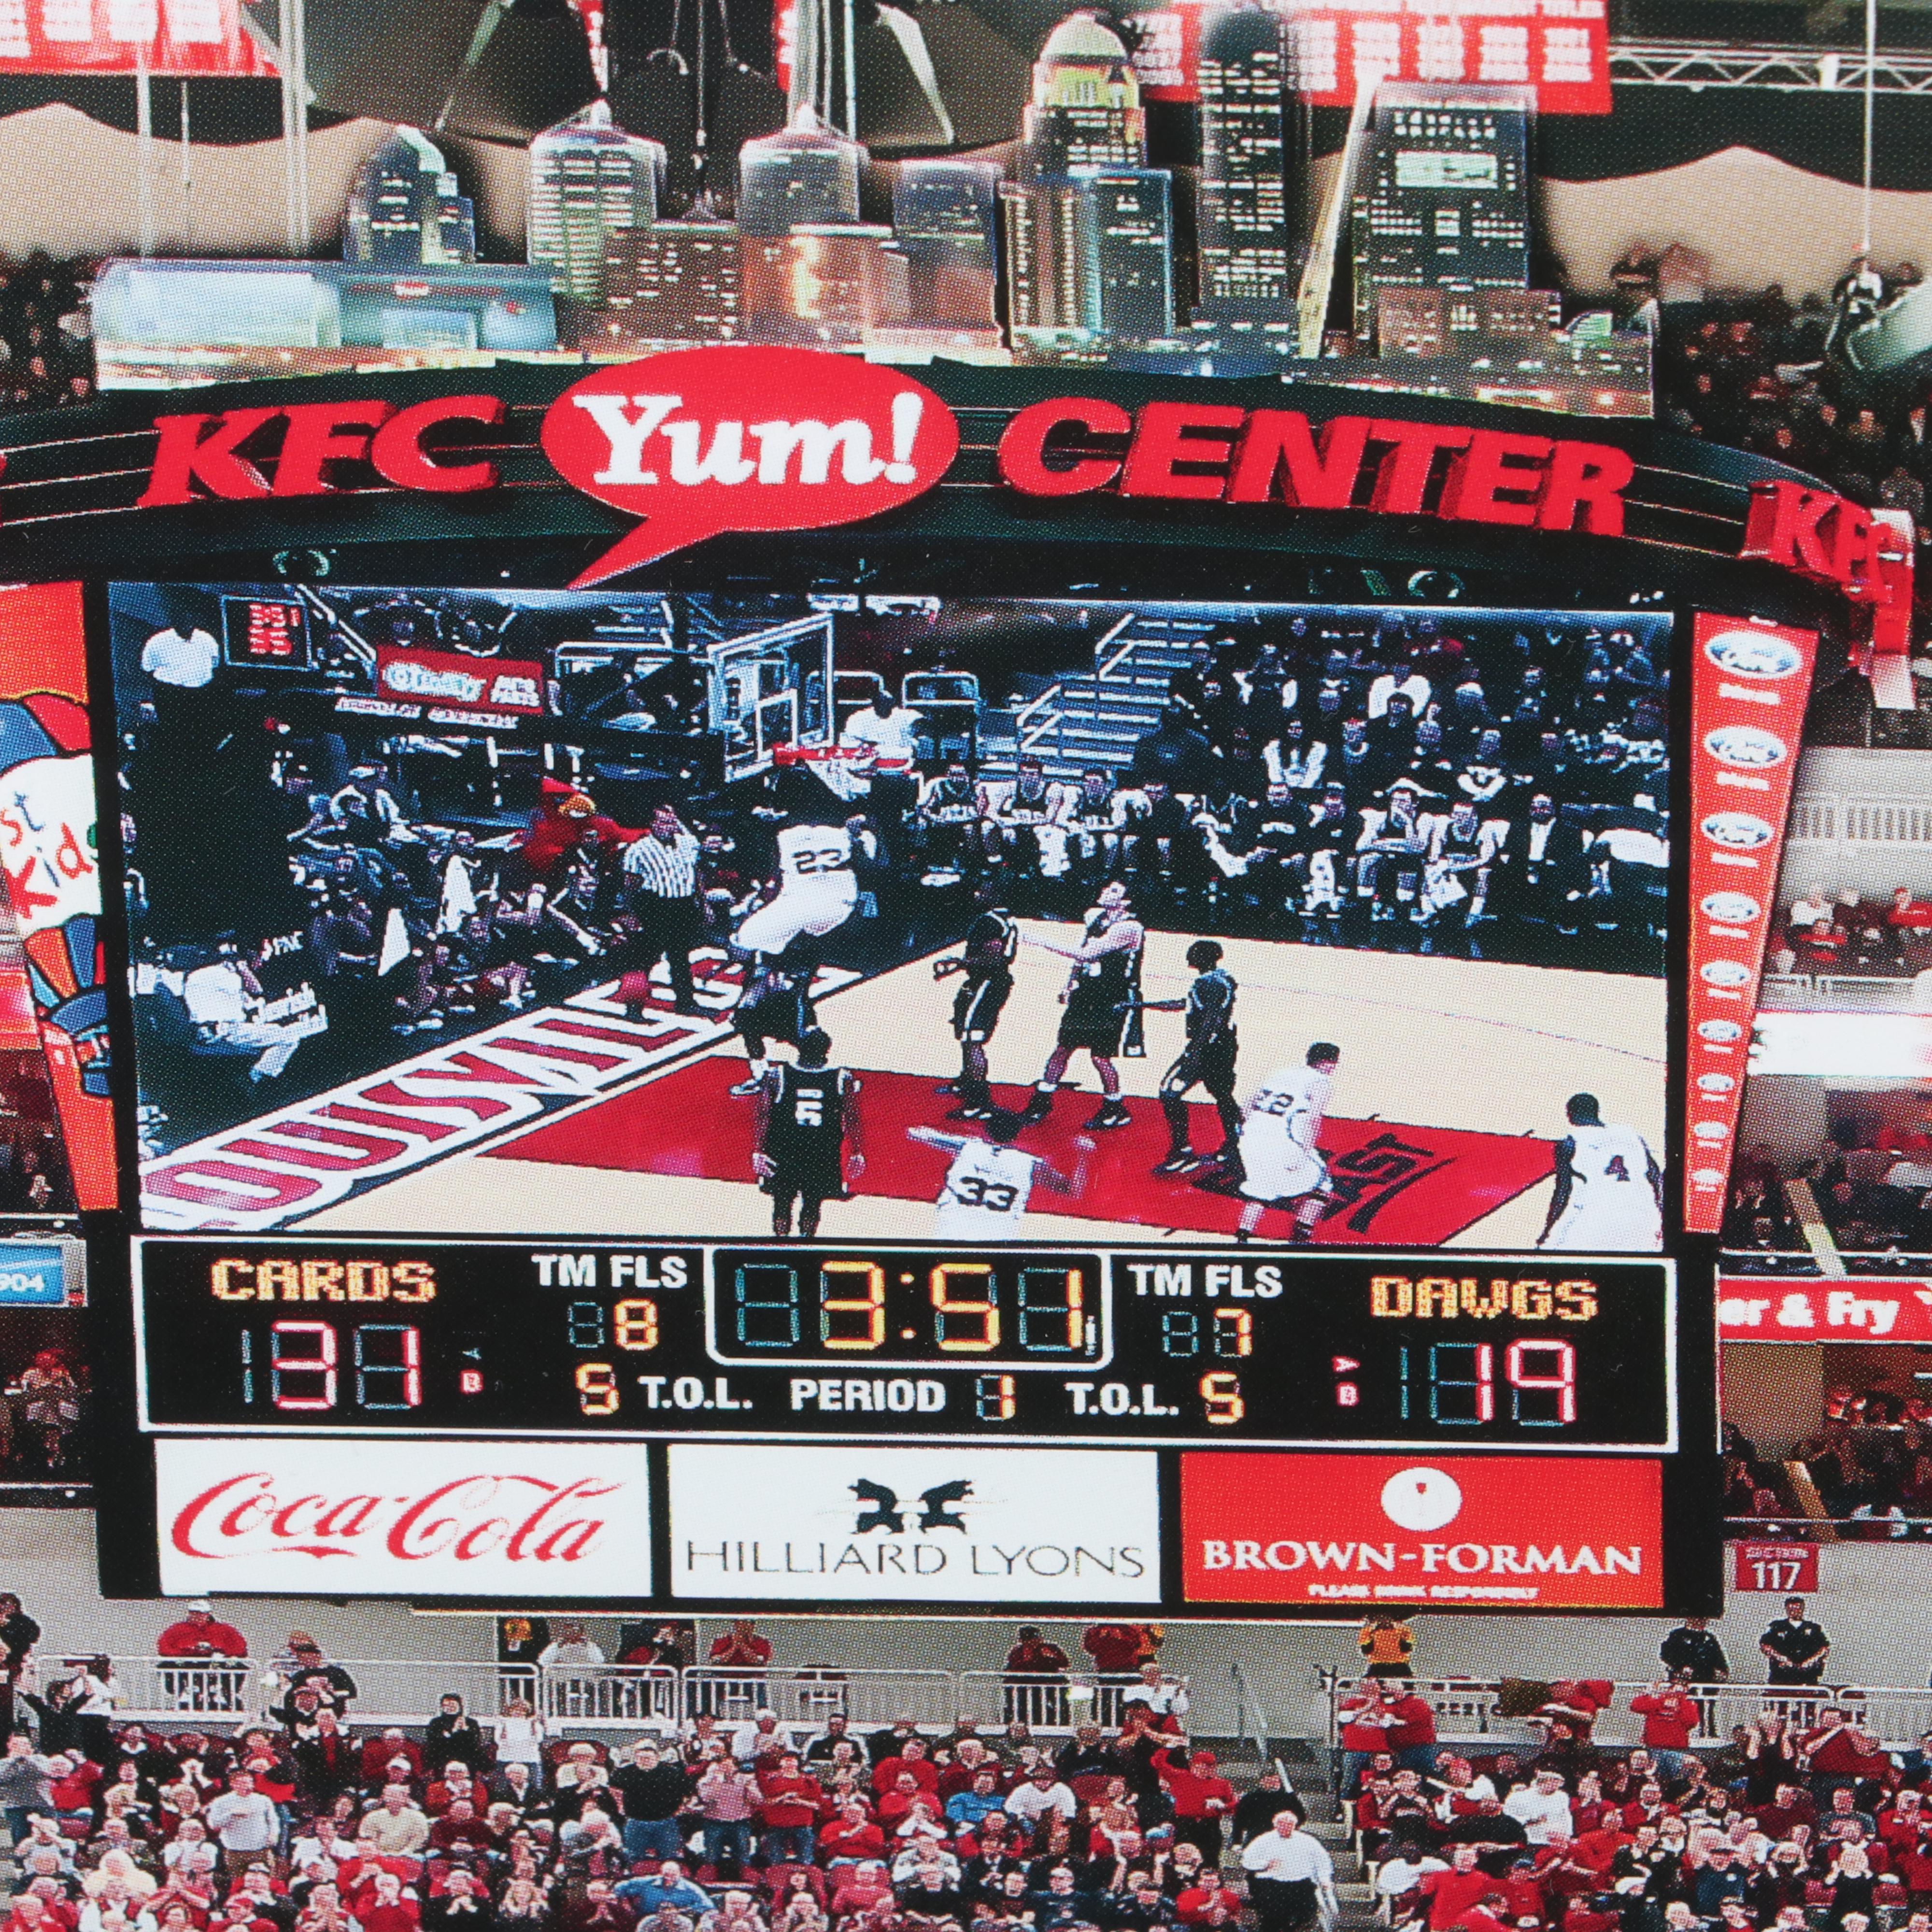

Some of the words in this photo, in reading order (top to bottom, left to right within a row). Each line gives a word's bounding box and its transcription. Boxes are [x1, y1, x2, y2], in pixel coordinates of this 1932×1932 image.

[135, 395, 506, 509] KFC
[572, 392, 923, 485] Yum!
[997, 396, 1635, 537] CENTER
[1605, 1154, 1630, 1181] 4
[958, 1175, 1018, 1213] 33
[211, 1258, 438, 1303] CARDS
[531, 1254, 597, 1287] TM
[610, 1254, 688, 1289] FLS
[1127, 1264, 1192, 1297] TM
[1205, 1264, 1283, 1299] FLS
[1371, 1276, 1599, 1321] DAWGS
[1776, 1293, 1815, 1328] &
[1827, 1290, 1901, 1335] Fry
[638, 1376, 754, 1410] T.O.L.
[790, 1378, 947, 1413] PERIOD
[1065, 1382, 1179, 1416] T.O.L.
[171, 1471, 626, 1562] Coca-Cola
[686, 1539, 948, 1576] HILLIARD
[970, 1544, 1146, 1579] LYONS
[1201, 1539, 1643, 1576] BROWN-FORMAN
[1752, 1561, 1802, 1590] 117
